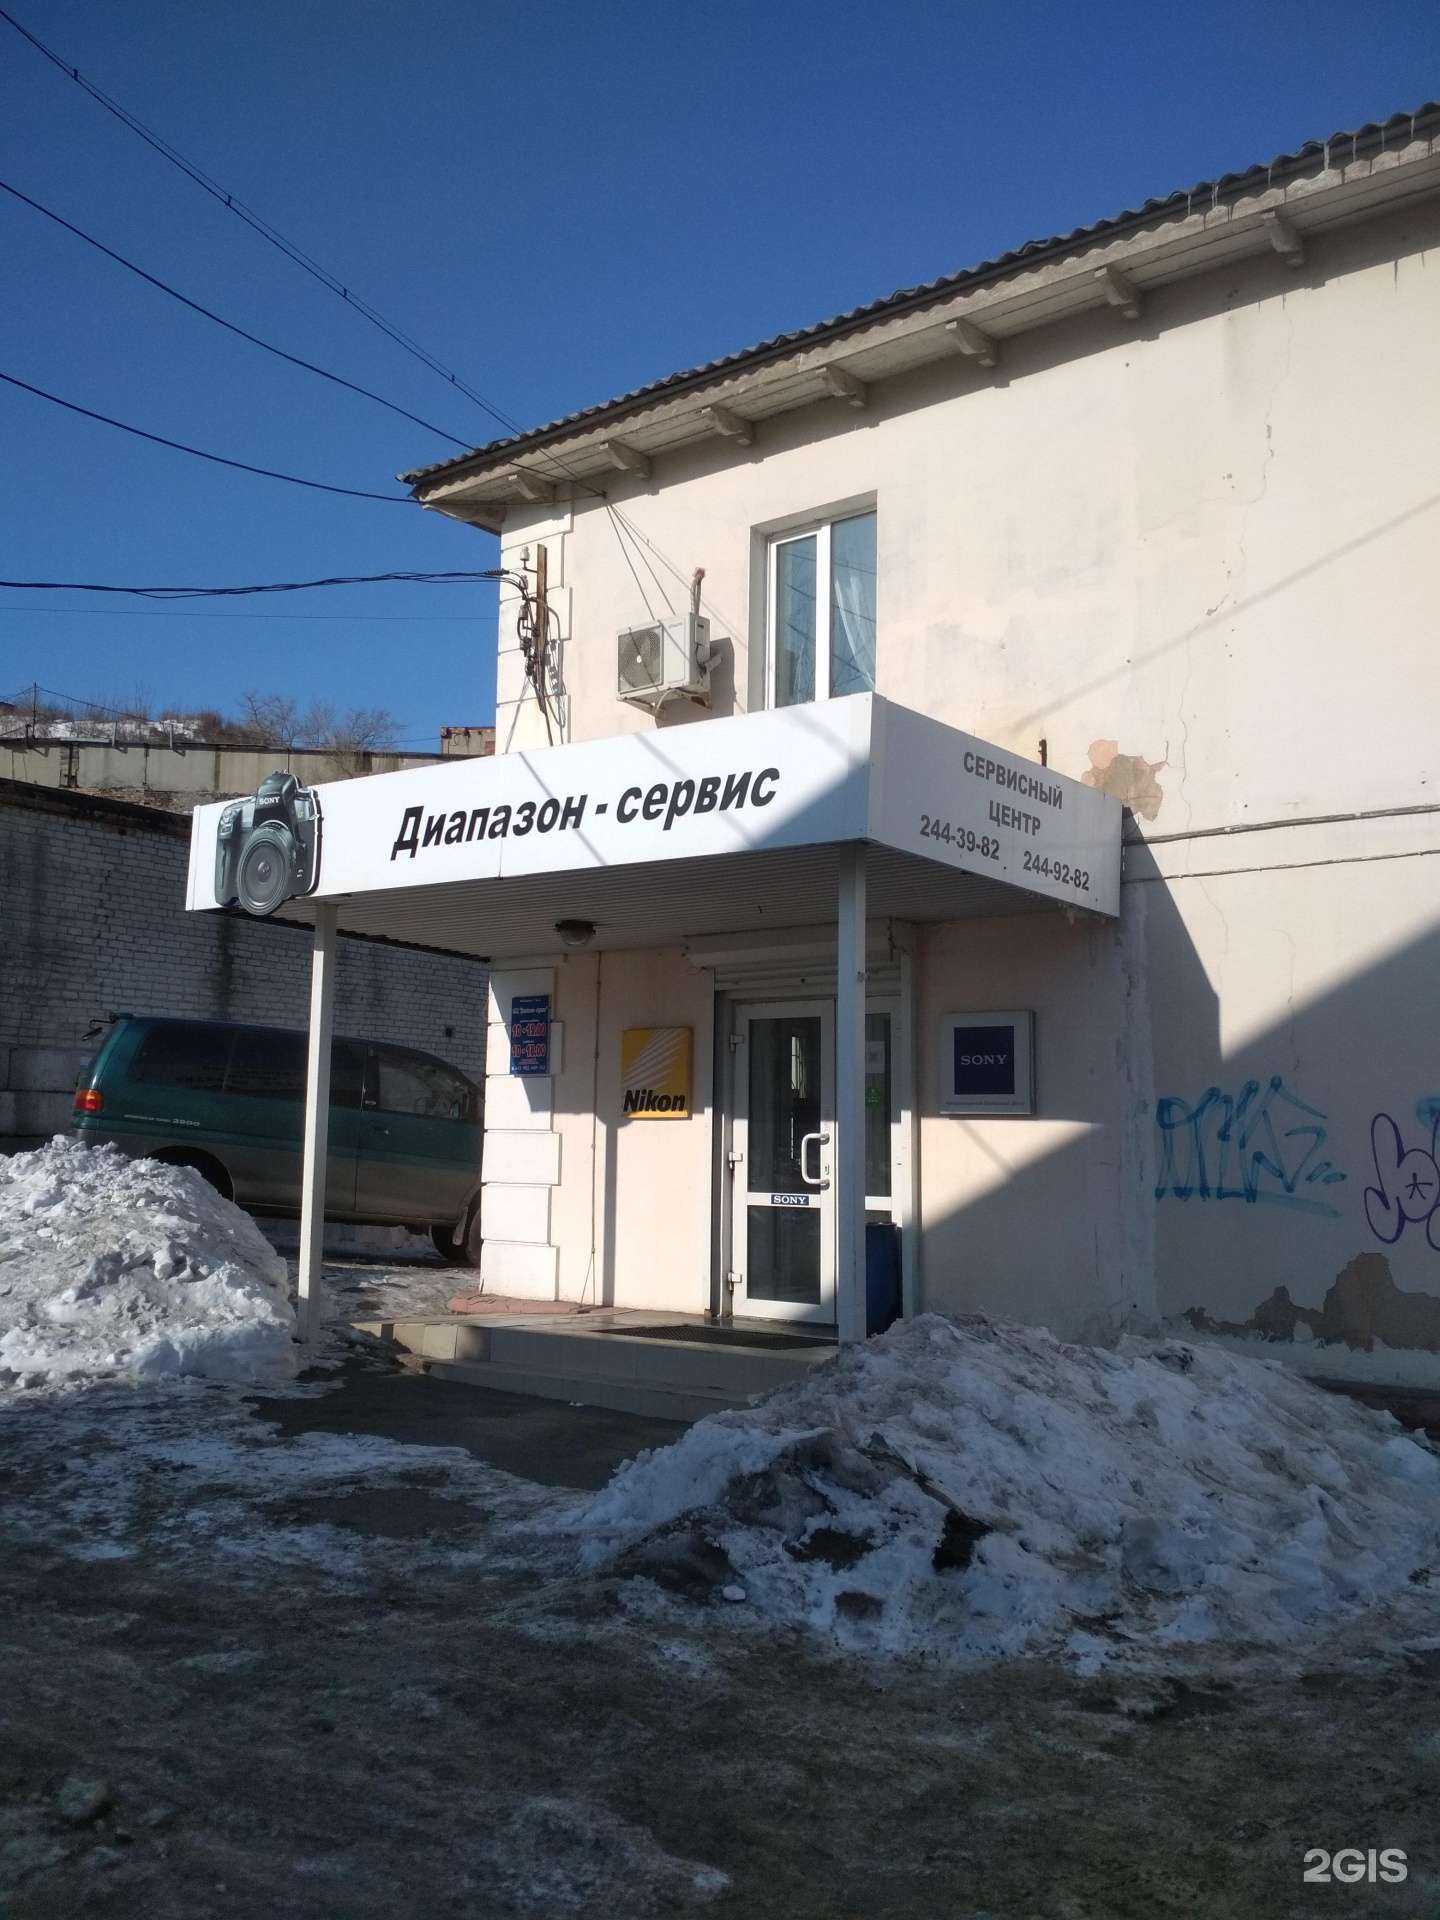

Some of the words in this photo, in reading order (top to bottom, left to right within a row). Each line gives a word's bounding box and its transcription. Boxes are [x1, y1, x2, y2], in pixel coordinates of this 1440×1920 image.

[963, 751, 1063, 810] СЕРВИСНЫЙ
[260, 796, 281, 806] SONY
[390, 794, 588, 861] Диапазон
[616, 767, 780, 831] сервис
[989, 799, 1041, 836] ЦЕНТР
[920, 814, 1000, 861] 244-39-82
[1023, 850, 1090, 891] 244-92-82
[960, 1054, 1008, 1066] SONY
[623, 1089, 686, 1113] Nikon
[773, 1195, 807, 1205] SONY
